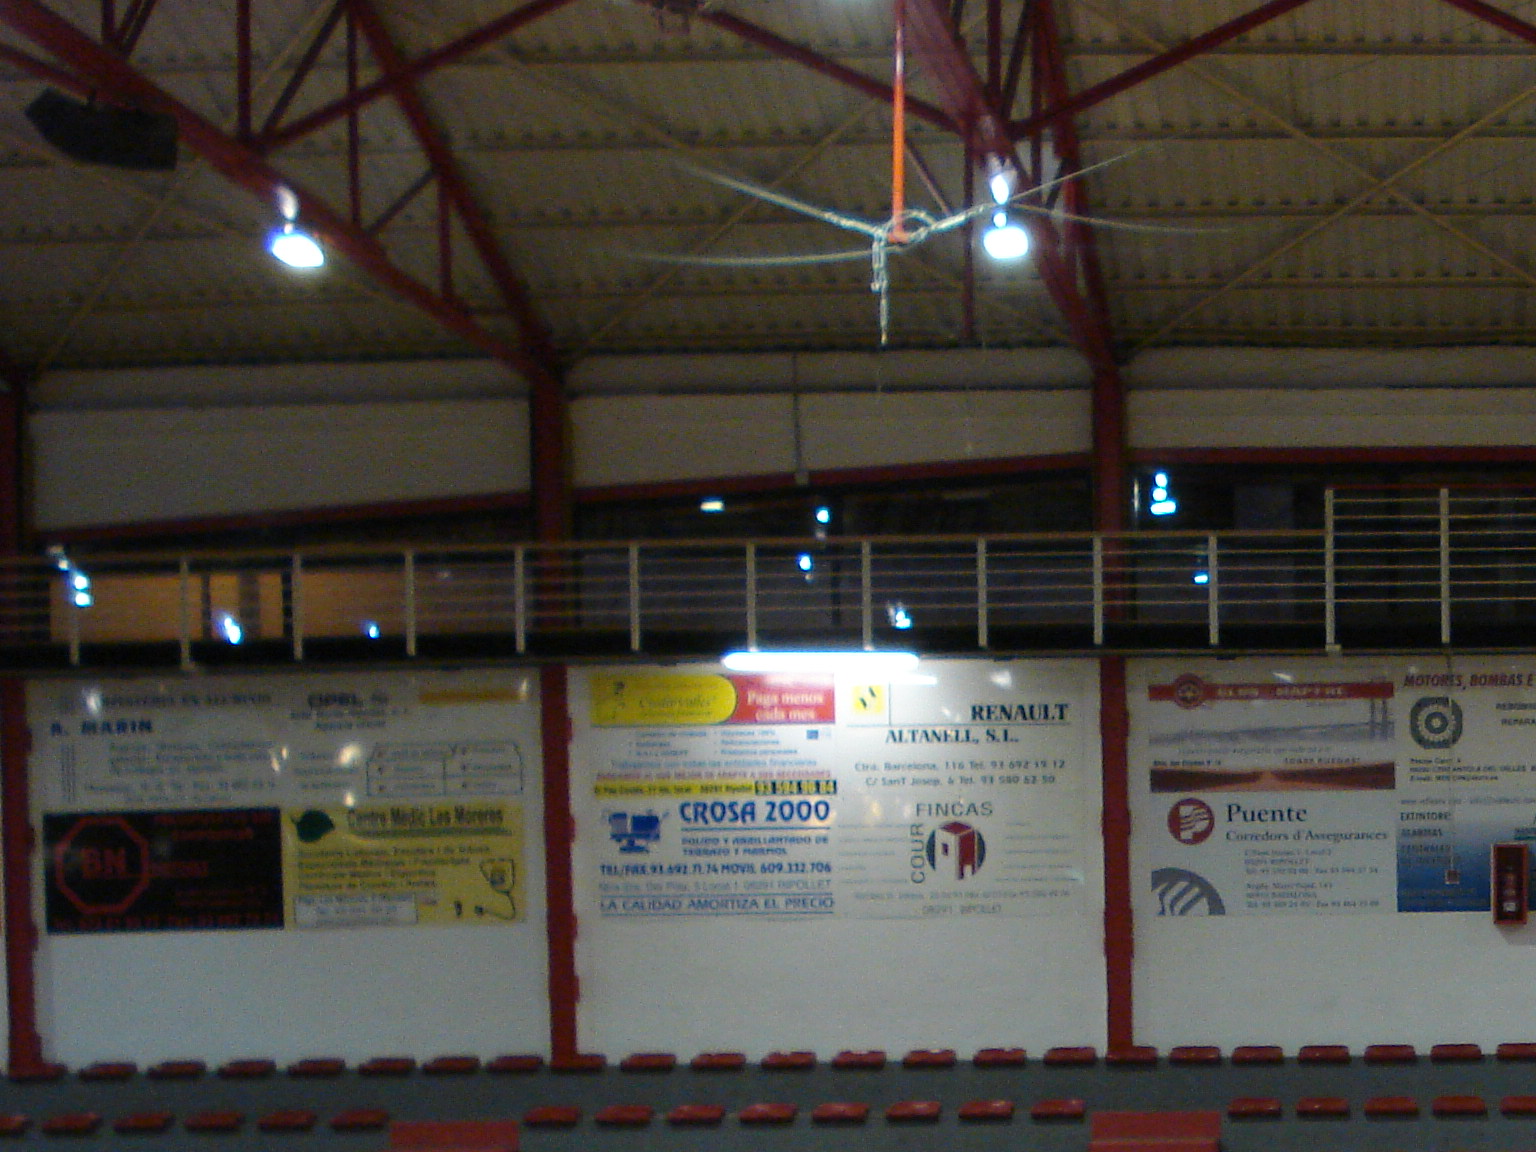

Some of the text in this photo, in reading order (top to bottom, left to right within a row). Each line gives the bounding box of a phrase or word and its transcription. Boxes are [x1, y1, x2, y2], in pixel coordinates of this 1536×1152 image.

[1470, 673, 1524, 687] BOMBAS
[1527, 673, 1535, 687] E
[970, 703, 1069, 721] RENAULT
[680, 800, 831, 825] CROSA 2000
[916, 802, 993, 817] FINCAS
[1226, 803, 1308, 823] Puente
[1225, 830, 1289, 842] Corredors
[910, 823, 925, 884] COUR
[622, 899, 682, 911] CALIDAD
[688, 898, 759, 911] AMORTIZA
[764, 898, 779, 909] EL
[785, 897, 833, 909] PRECIO
